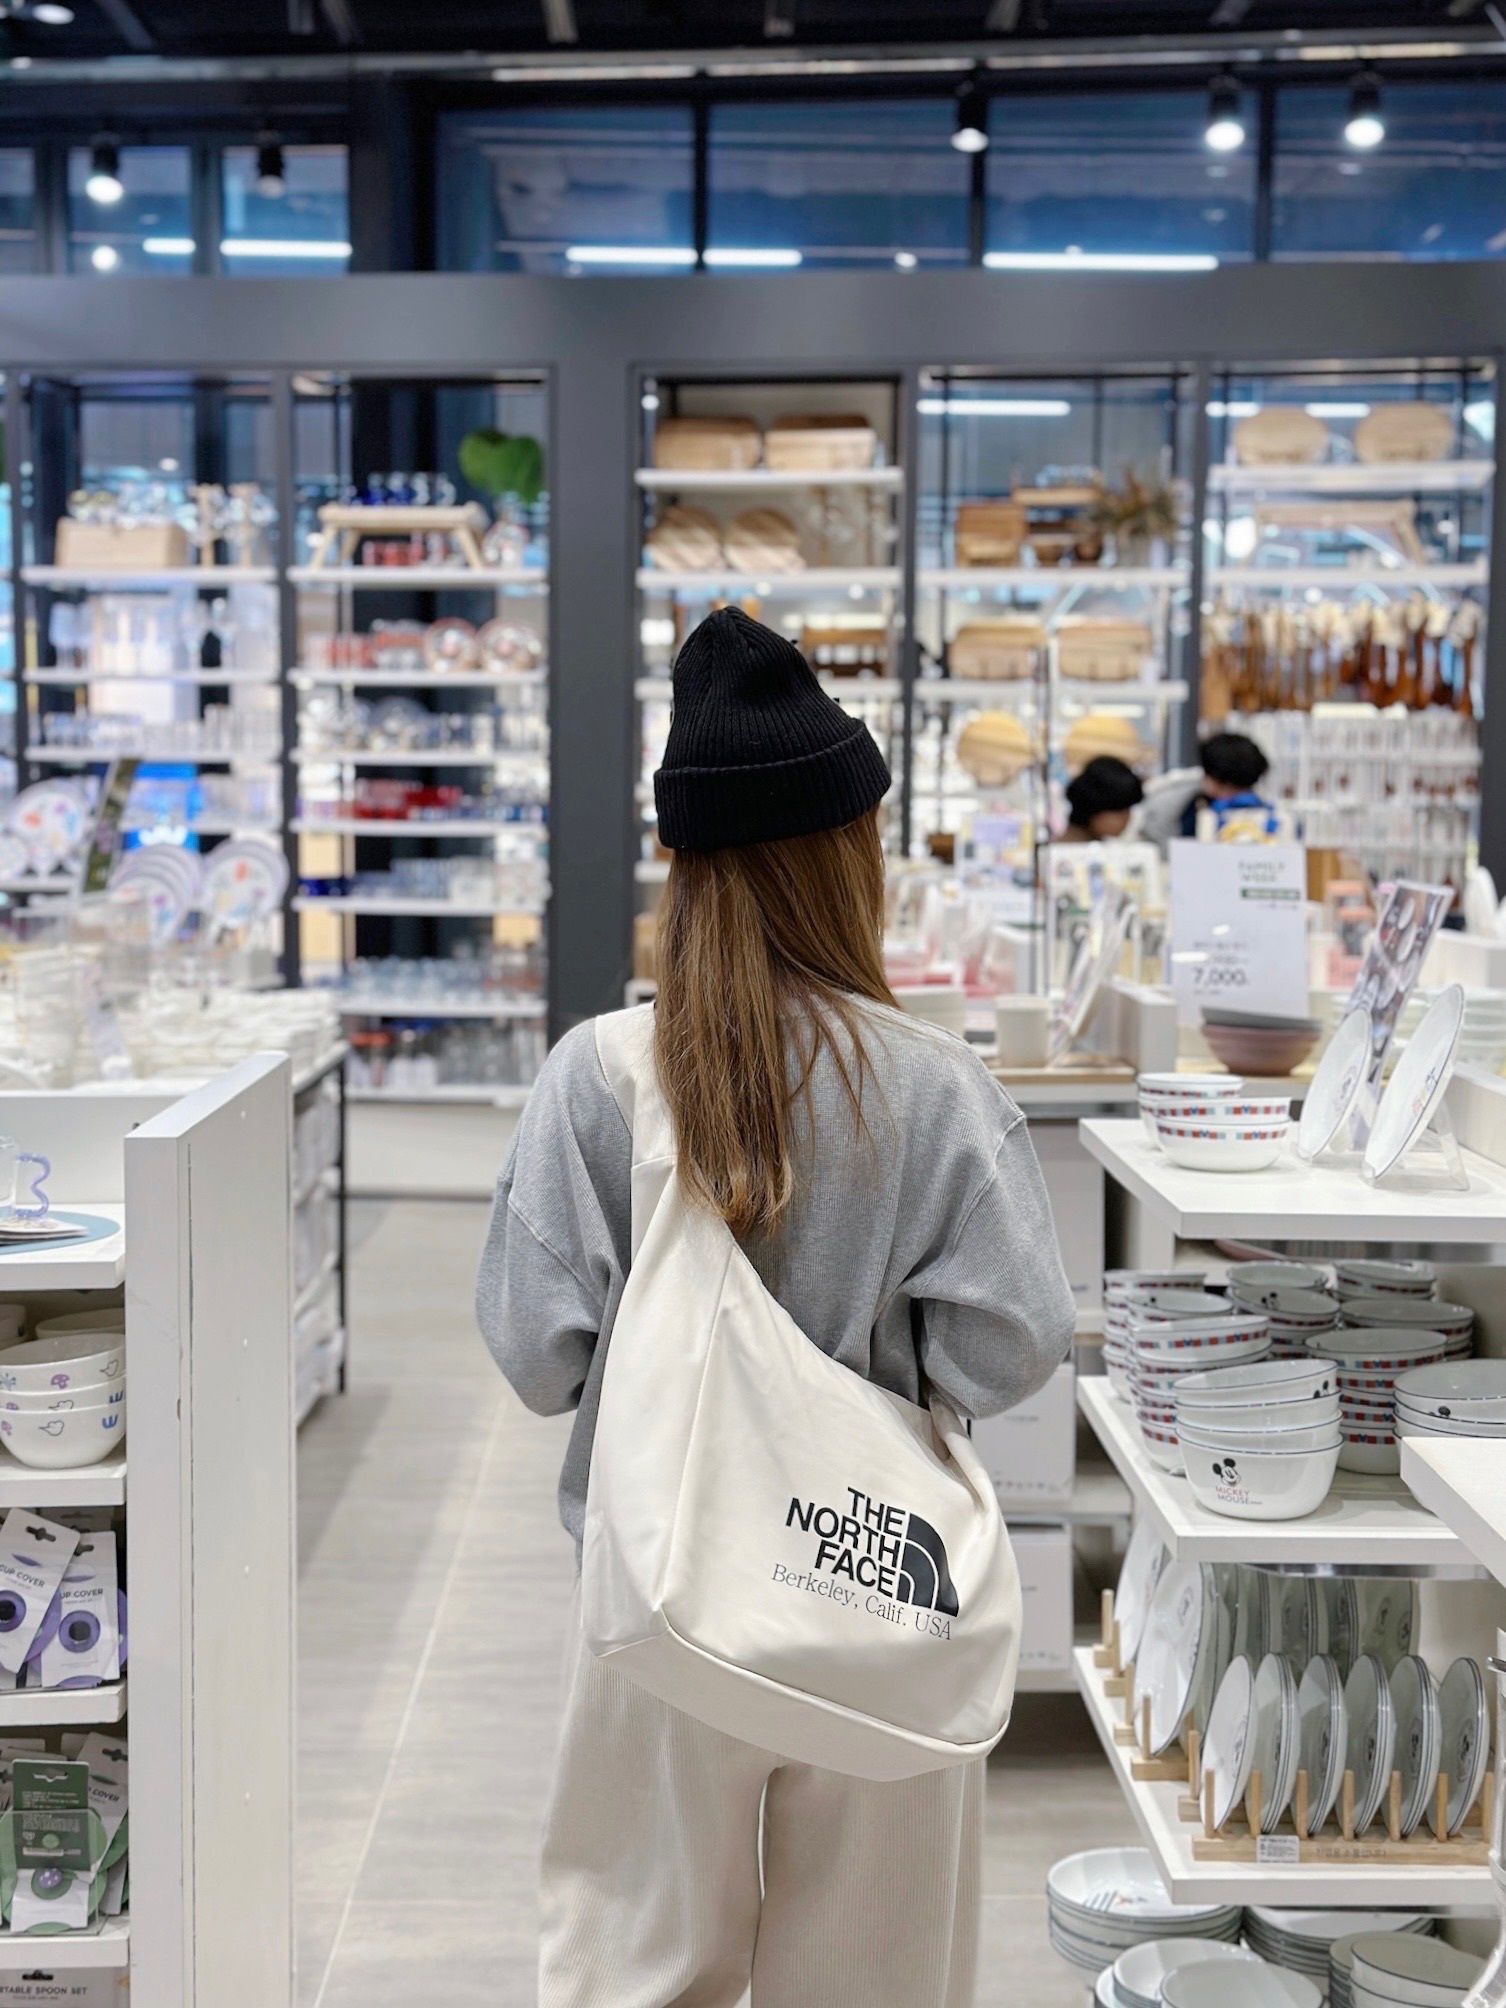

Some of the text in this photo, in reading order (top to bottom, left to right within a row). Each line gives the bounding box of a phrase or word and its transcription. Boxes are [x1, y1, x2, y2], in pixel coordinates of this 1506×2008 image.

[1215, 1486, 1249, 1497] MICKEY
[1217, 1494, 1250, 1505] MOUSE
[847, 1486, 906, 1538] THE
[785, 1497, 901, 1568] NORTH
[814, 1539, 897, 1598] FACE
[16, 1571, 45, 1588] COVER
[73, 1588, 104, 1598] COVER
[772, 1563, 951, 1640] Berkeley, Calif. USA
[92, 1787, 120, 1802] COVER
[36, 1986, 67, 1995] SPOON
[71, 1986, 88, 1995] SET
